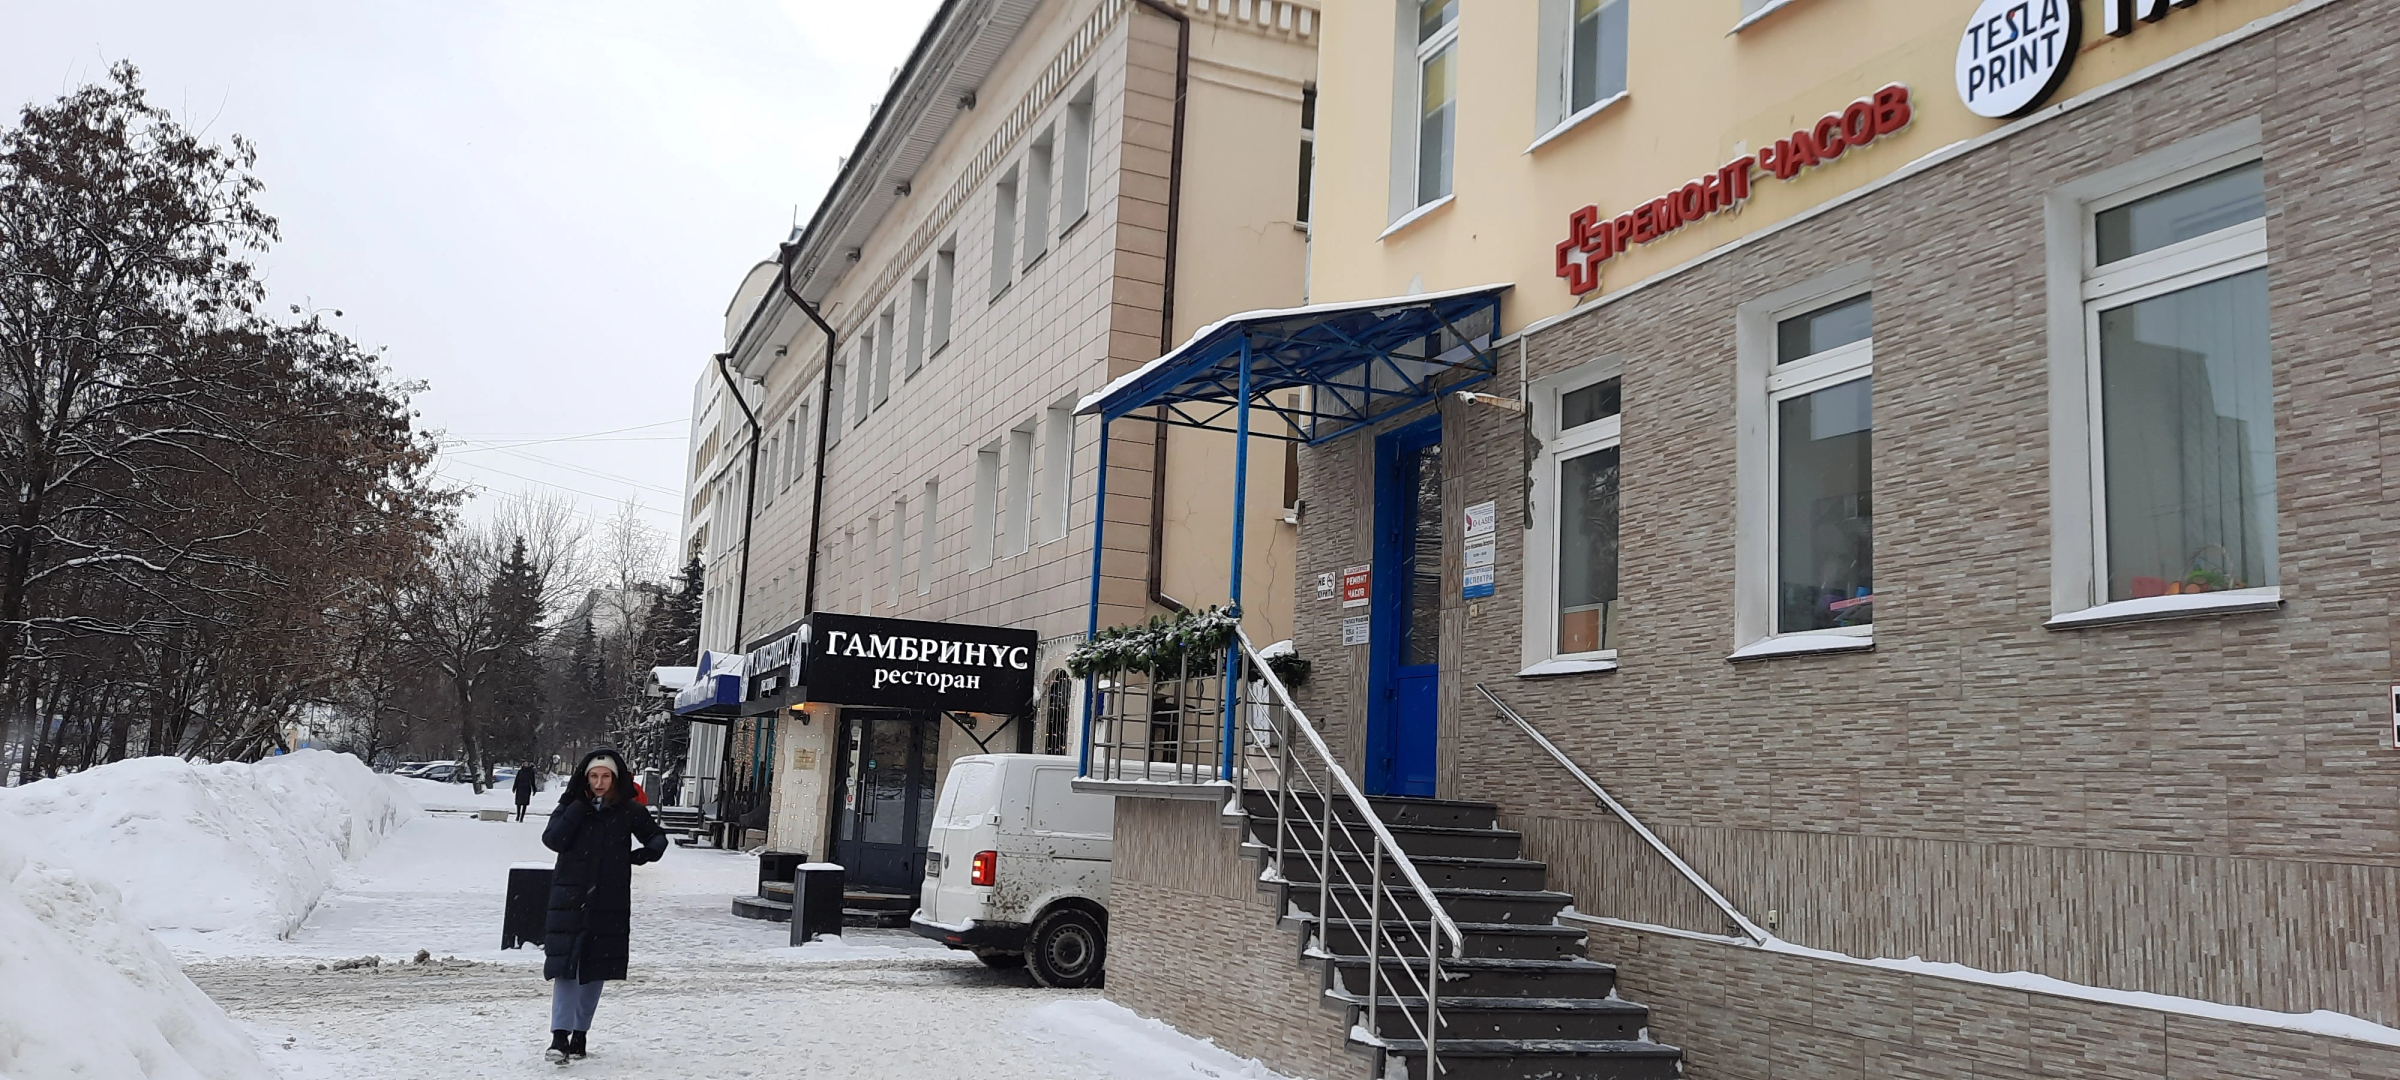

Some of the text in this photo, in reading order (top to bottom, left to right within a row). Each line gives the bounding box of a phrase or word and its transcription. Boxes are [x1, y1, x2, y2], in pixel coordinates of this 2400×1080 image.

[1967, 0, 2060, 61] TESLA
[1968, 26, 2061, 103] PRINT
[1612, 82, 1914, 253] РЕМОНТ ЧАСОВ
[1346, 575, 1367, 586] РЕМОНТ
[1348, 588, 1365, 598] ЧАСОВ
[873, 666, 981, 693] ресторан
